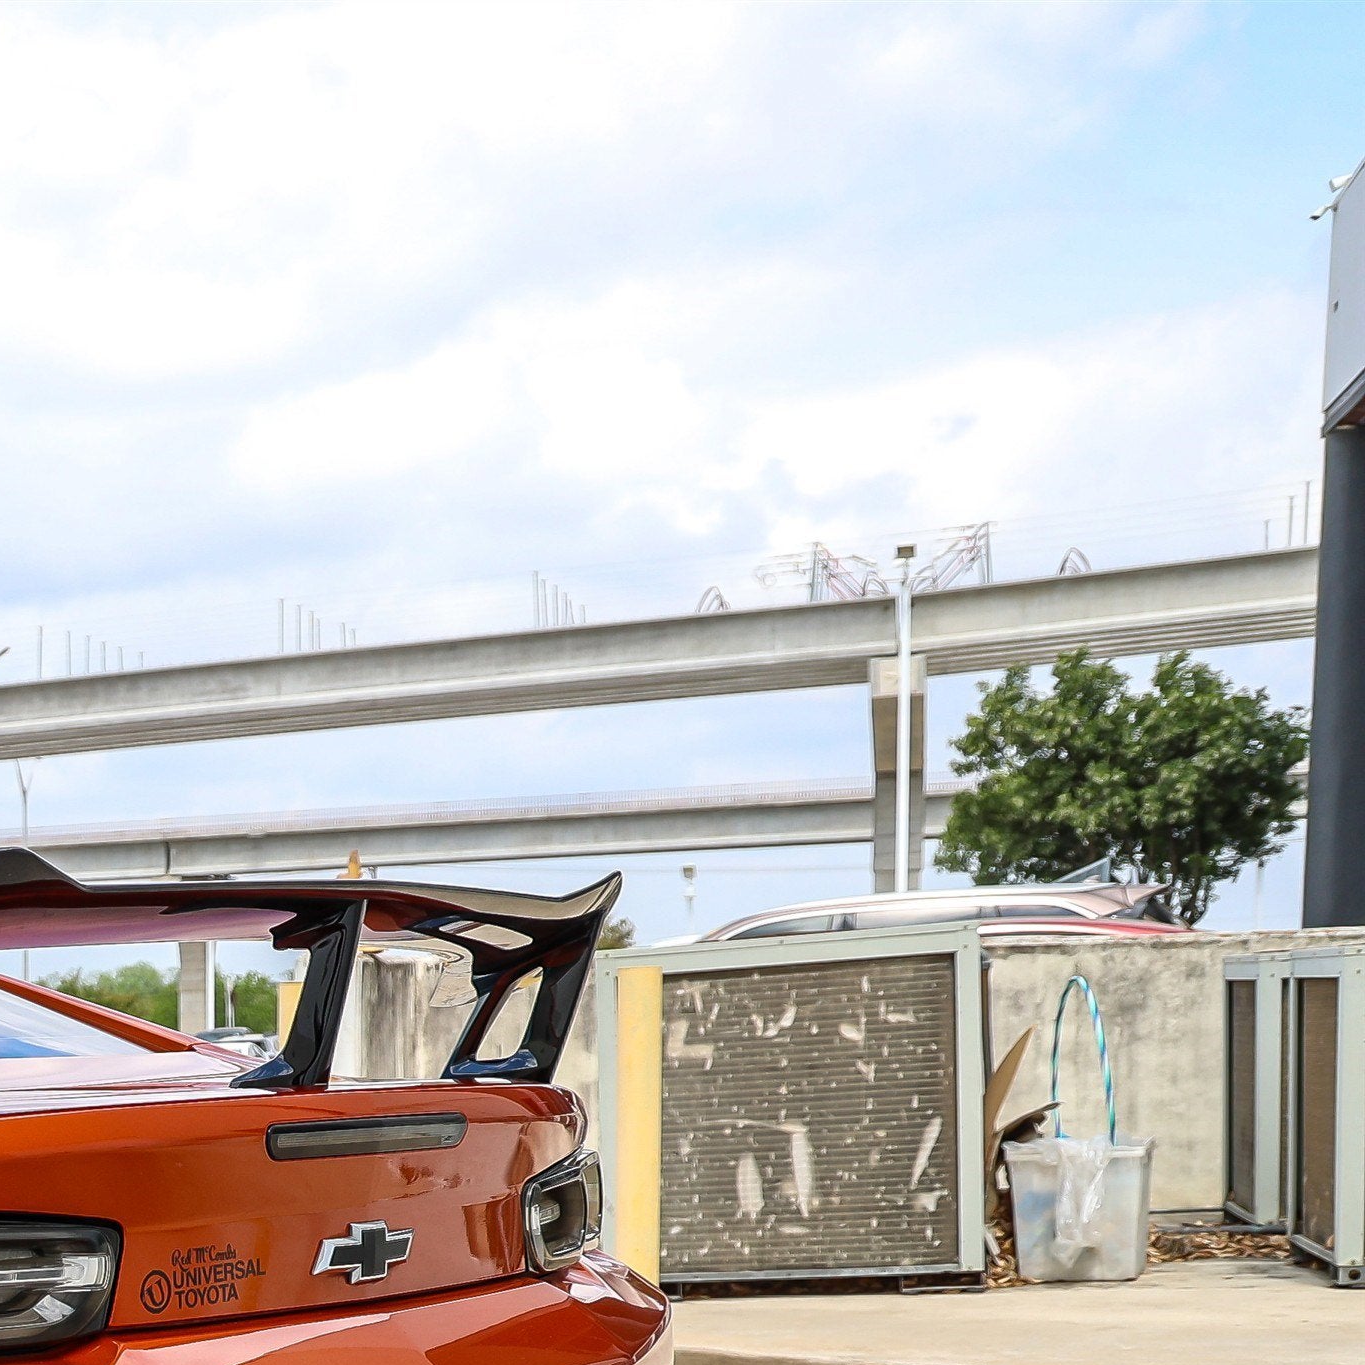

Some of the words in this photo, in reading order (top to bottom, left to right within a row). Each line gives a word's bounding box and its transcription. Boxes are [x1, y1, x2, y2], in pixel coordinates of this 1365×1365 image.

[171, 1249, 192, 1272] Red
[173, 1258, 267, 1289] UNIVERSAL
[174, 1282, 239, 1309] TOYOTA
